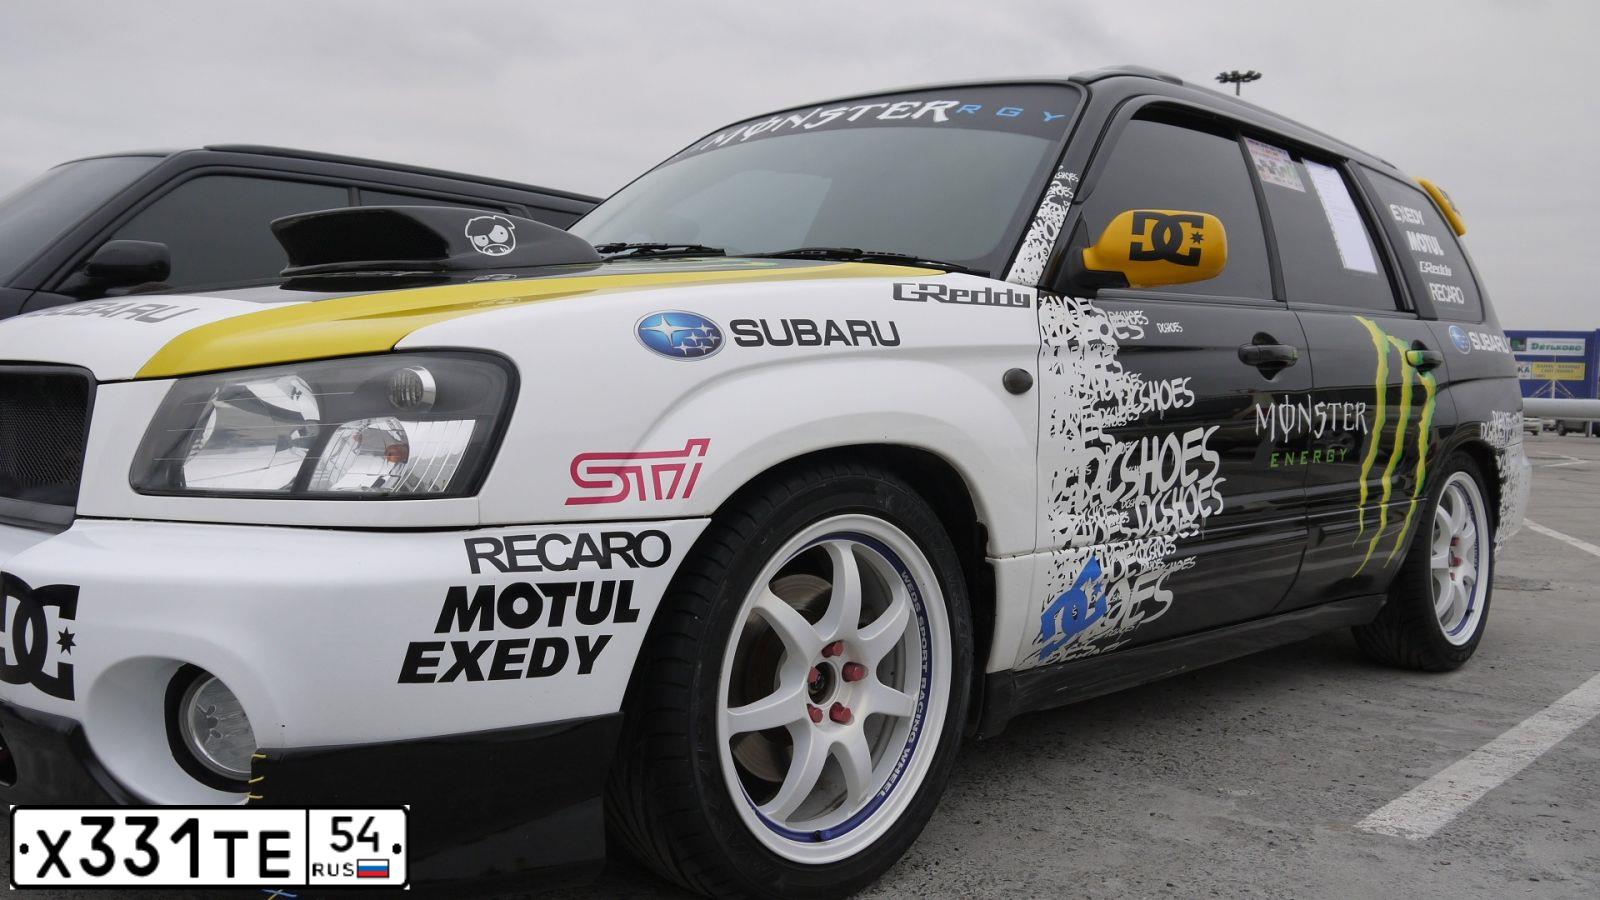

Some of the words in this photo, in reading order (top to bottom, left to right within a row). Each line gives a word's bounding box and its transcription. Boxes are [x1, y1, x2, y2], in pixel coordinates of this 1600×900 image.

[1390, 204, 1425, 225] EXEDY
[1129, 211, 1204, 267] DC
[1406, 230, 1444, 256] MOTUL
[893, 282, 1031, 308] GReddy
[1429, 282, 1464, 304] RECARO
[729, 318, 901, 348] SUBARU
[1468, 331, 1510, 354] SUBARU
[1270, 448, 1348, 468] ENERGY
[464, 529, 672, 574] RECARO
[434, 580, 640, 633] MOTUL
[901, 571, 922, 610] WEDS
[397, 635, 612, 684] EXEDY
[918, 614, 929, 672] SPORT
[910, 679, 929, 743] RACING
[876, 748, 917, 798] WHEEL
